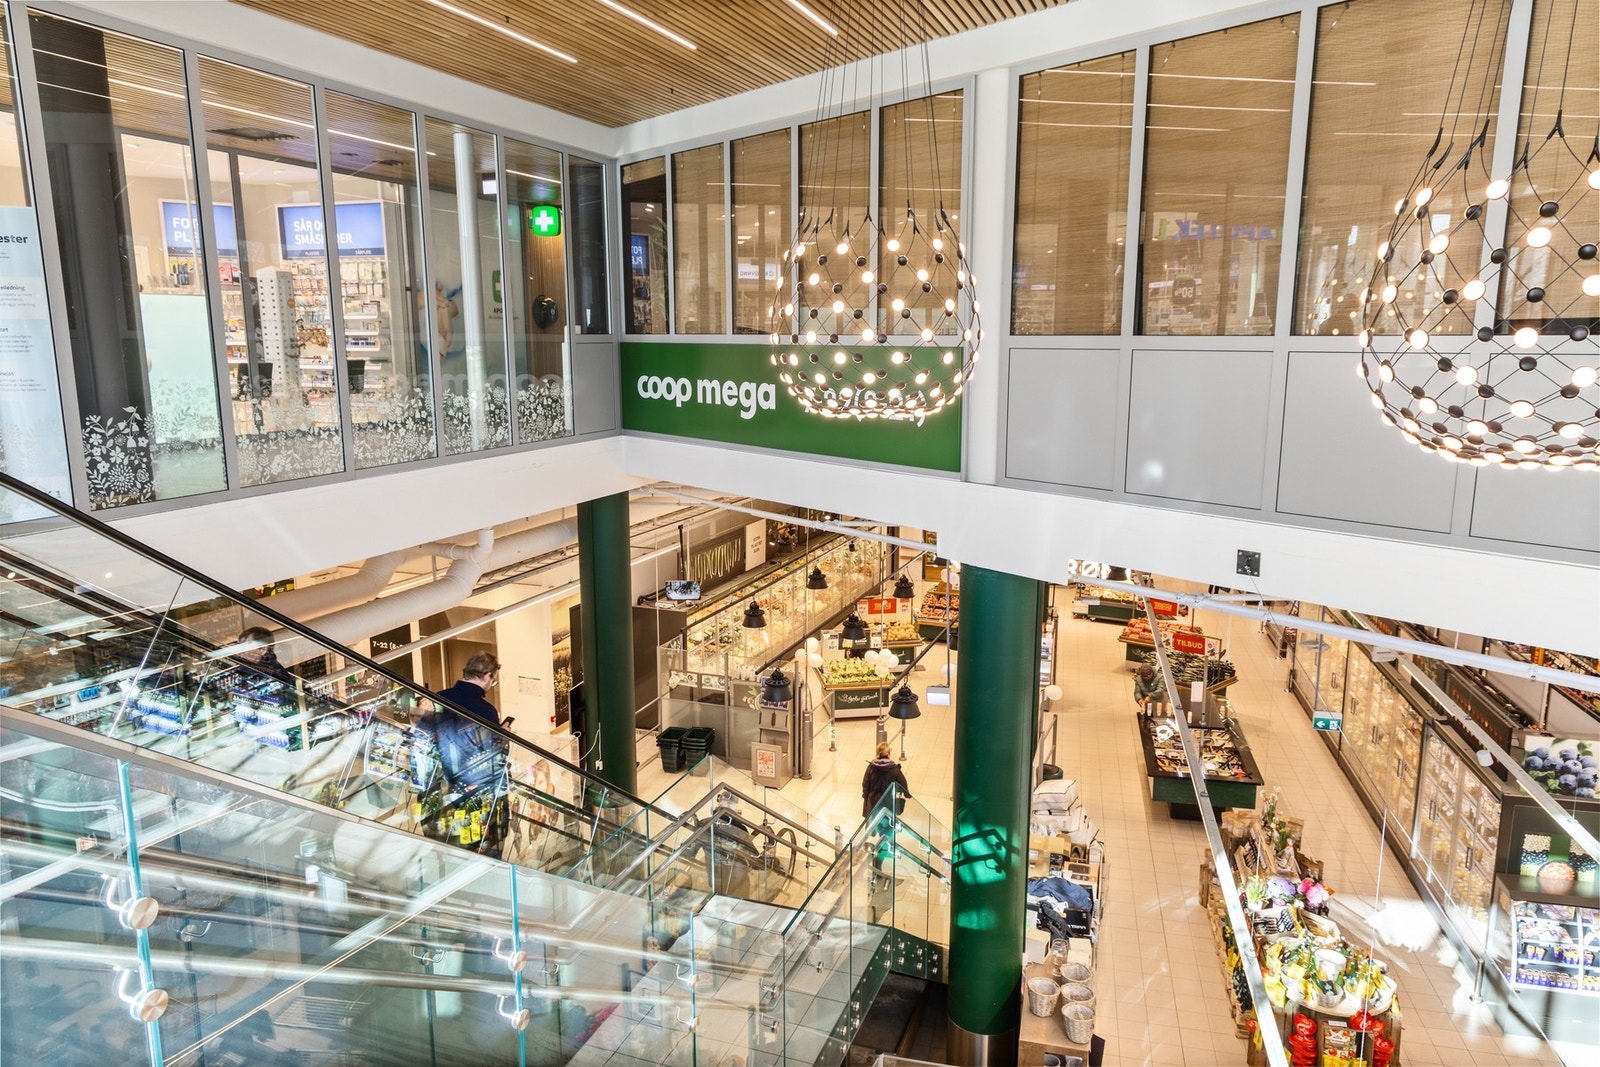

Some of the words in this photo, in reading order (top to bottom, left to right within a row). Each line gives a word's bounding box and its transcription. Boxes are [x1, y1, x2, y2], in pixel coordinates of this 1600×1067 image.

[294, 217, 313, 231] SÅR
[314, 220, 323, 231] O
[637, 375, 693, 408] coop
[696, 379, 776, 420] mega
[1176, 639, 1203, 650] TILBUD
